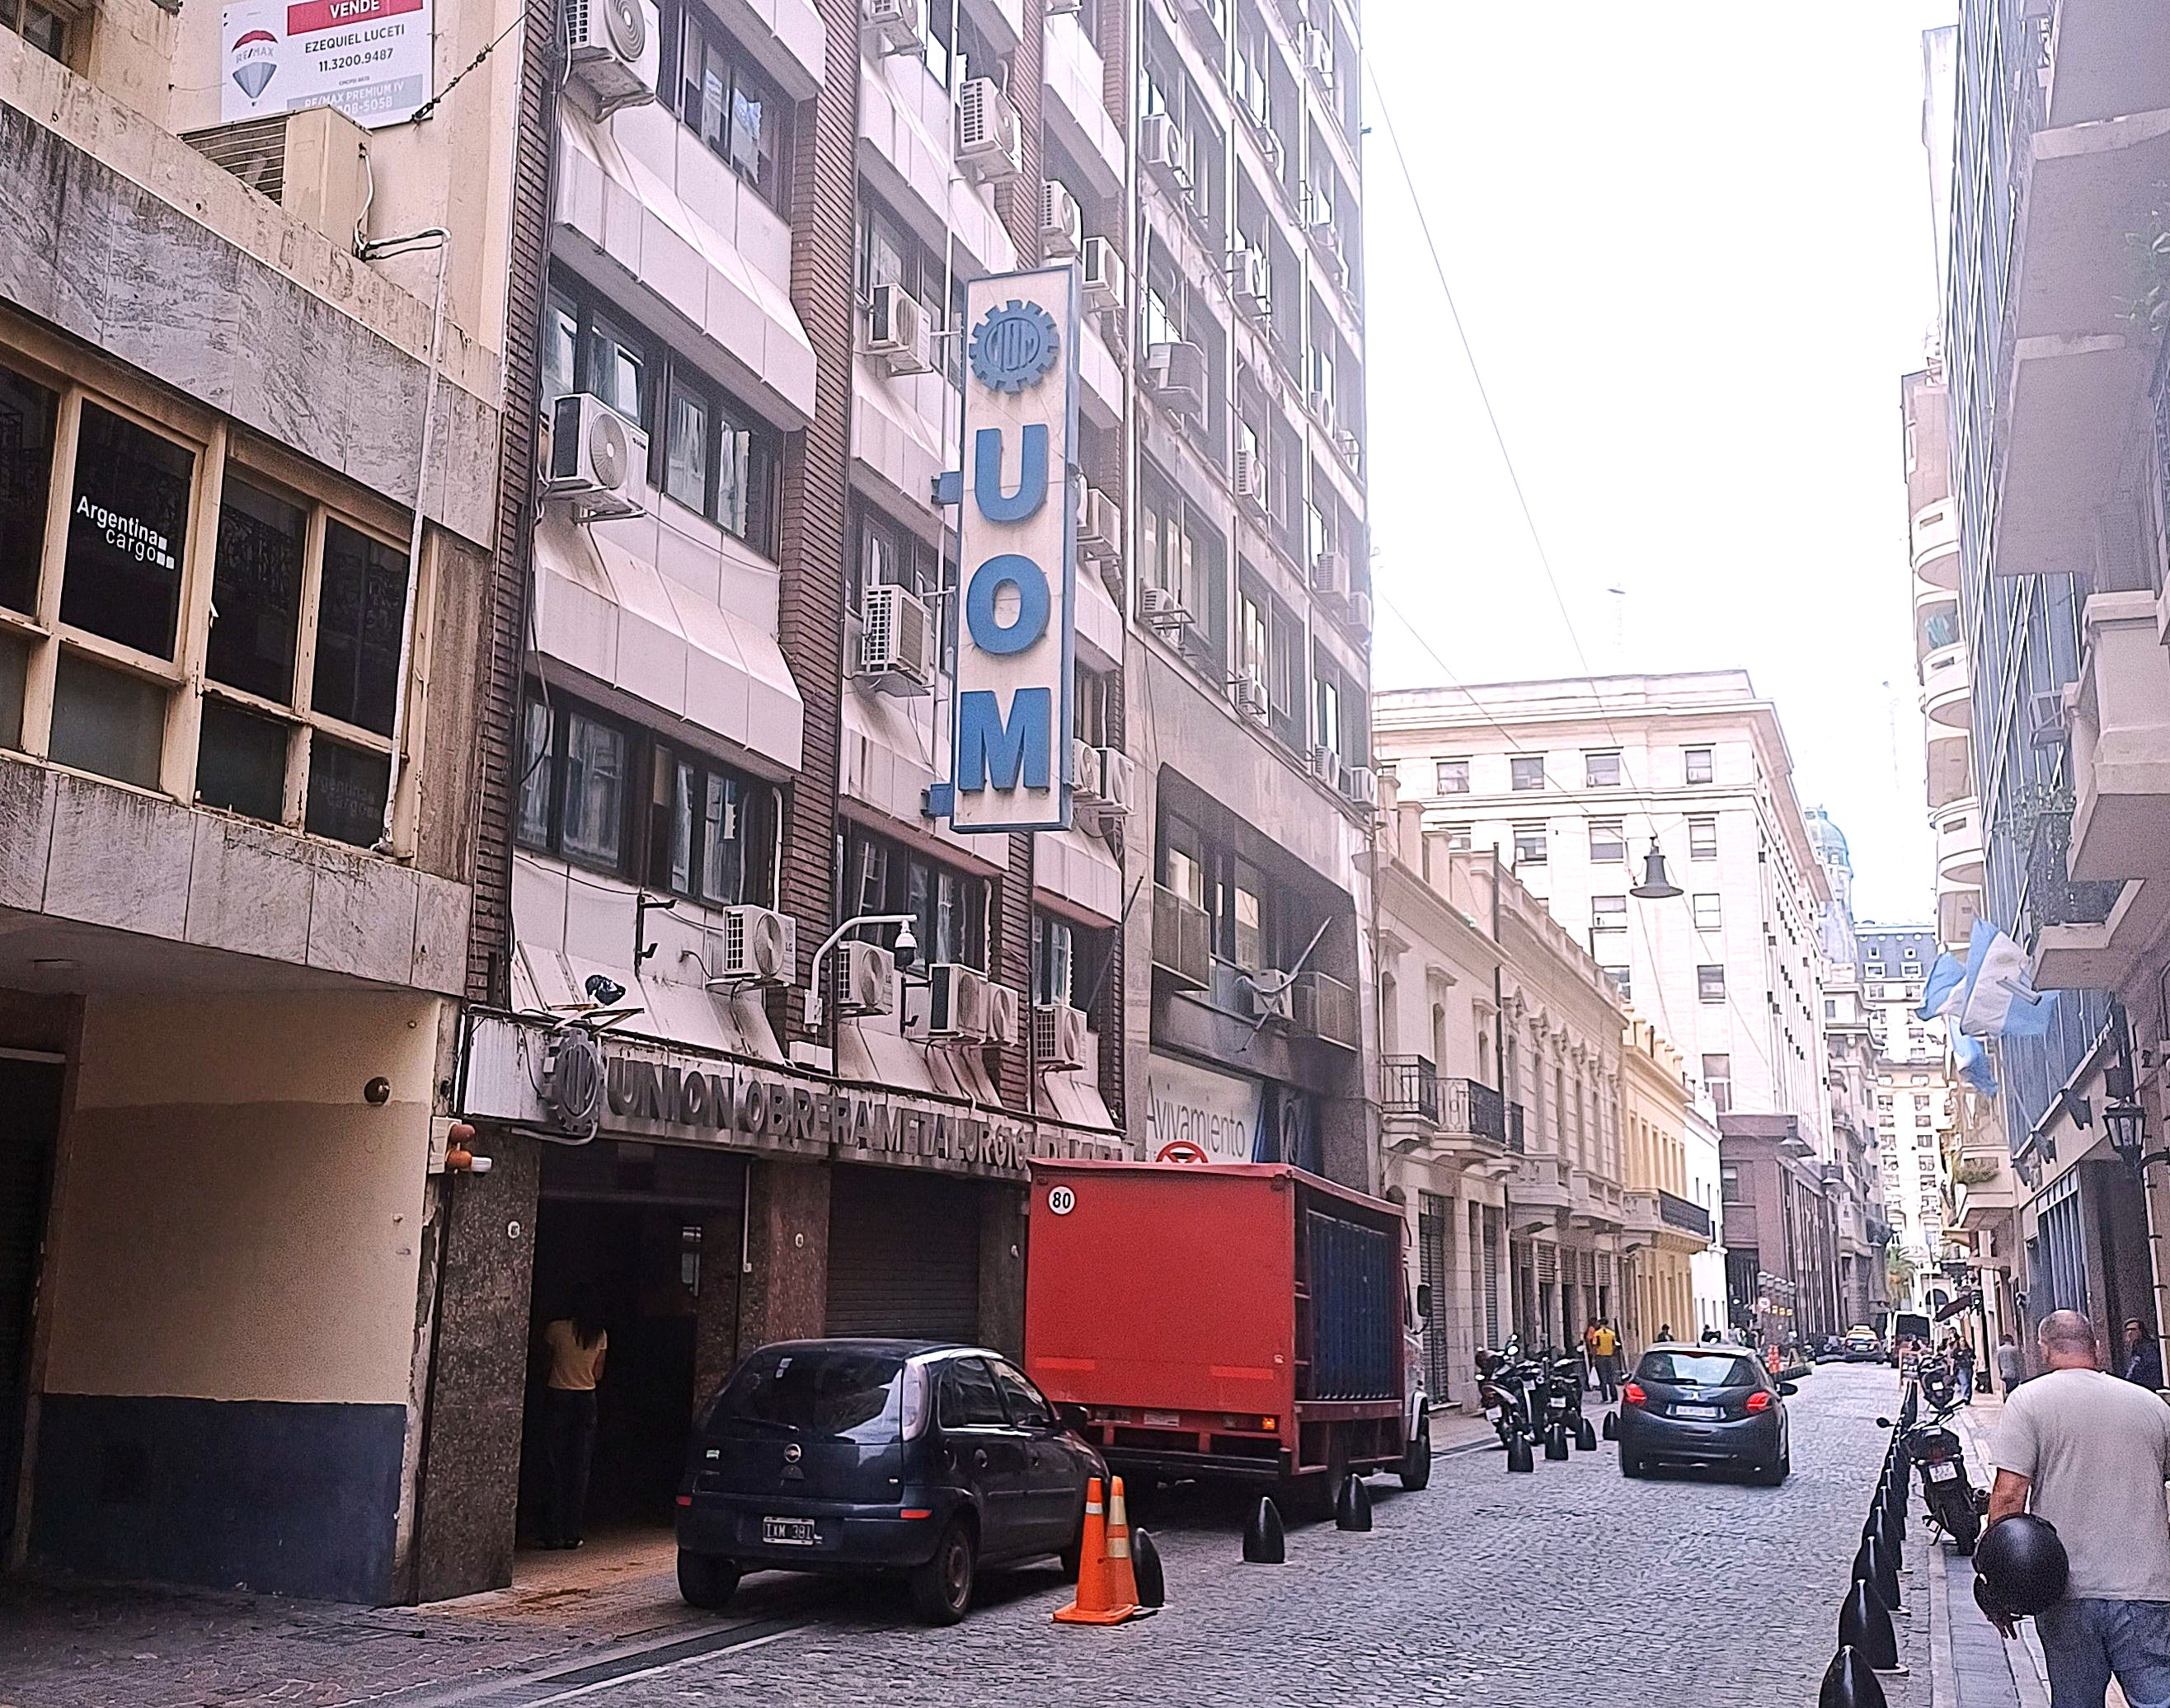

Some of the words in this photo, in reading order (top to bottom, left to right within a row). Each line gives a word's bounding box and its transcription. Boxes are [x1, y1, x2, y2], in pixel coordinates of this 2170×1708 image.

[330, 0, 380, 18] VENDE
[304, 34, 362, 54] EZEQUIEL
[364, 24, 405, 43] LUCETI
[236, 47, 275, 64] RE/MAX
[318, 48, 394, 73] 11.3200.9487
[348, 83, 392, 101] PREMIUM
[393, 81, 405, 92] IV
[77, 495, 157, 546] Argentina
[106, 529, 156, 561] cargo
[961, 424, 1050, 795] UOM
[608, 1057, 733, 1129] UNION
[745, 1081, 871, 1150] OBRERA
[1146, 1074, 1246, 1158] Avivamiento
[1052, 1191, 1072, 1210] 80
